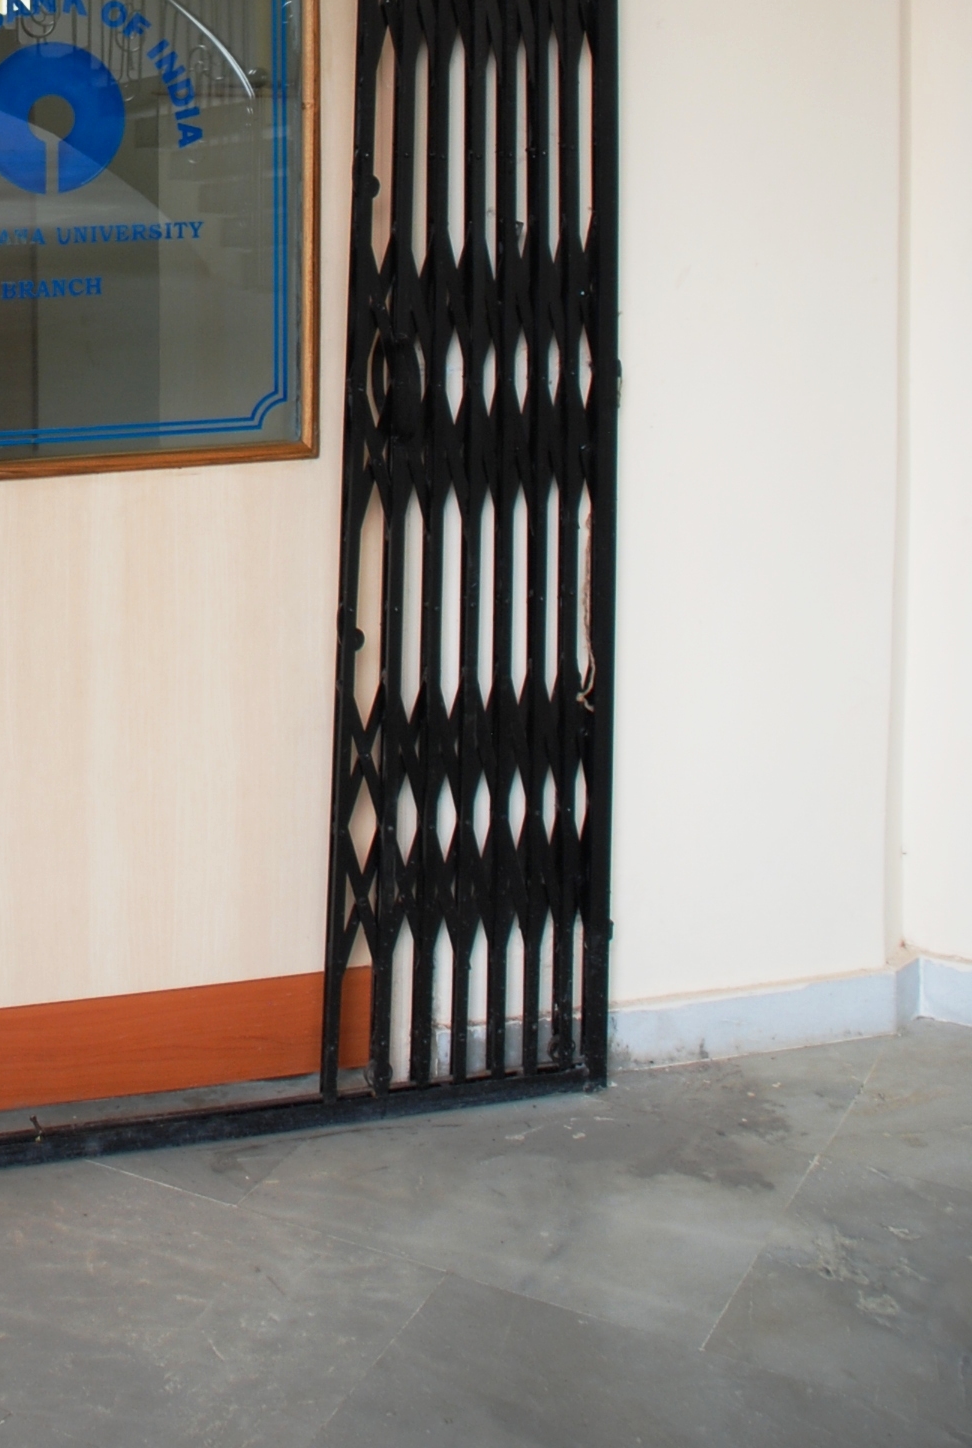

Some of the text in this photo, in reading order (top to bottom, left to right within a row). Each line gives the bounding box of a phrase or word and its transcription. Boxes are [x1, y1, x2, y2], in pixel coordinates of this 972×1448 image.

[100, 0, 152, 39] OF
[146, 38, 204, 148] INDIA
[56, 221, 204, 245] UNIVERSITY
[0, 277, 103, 300] BRANCH
